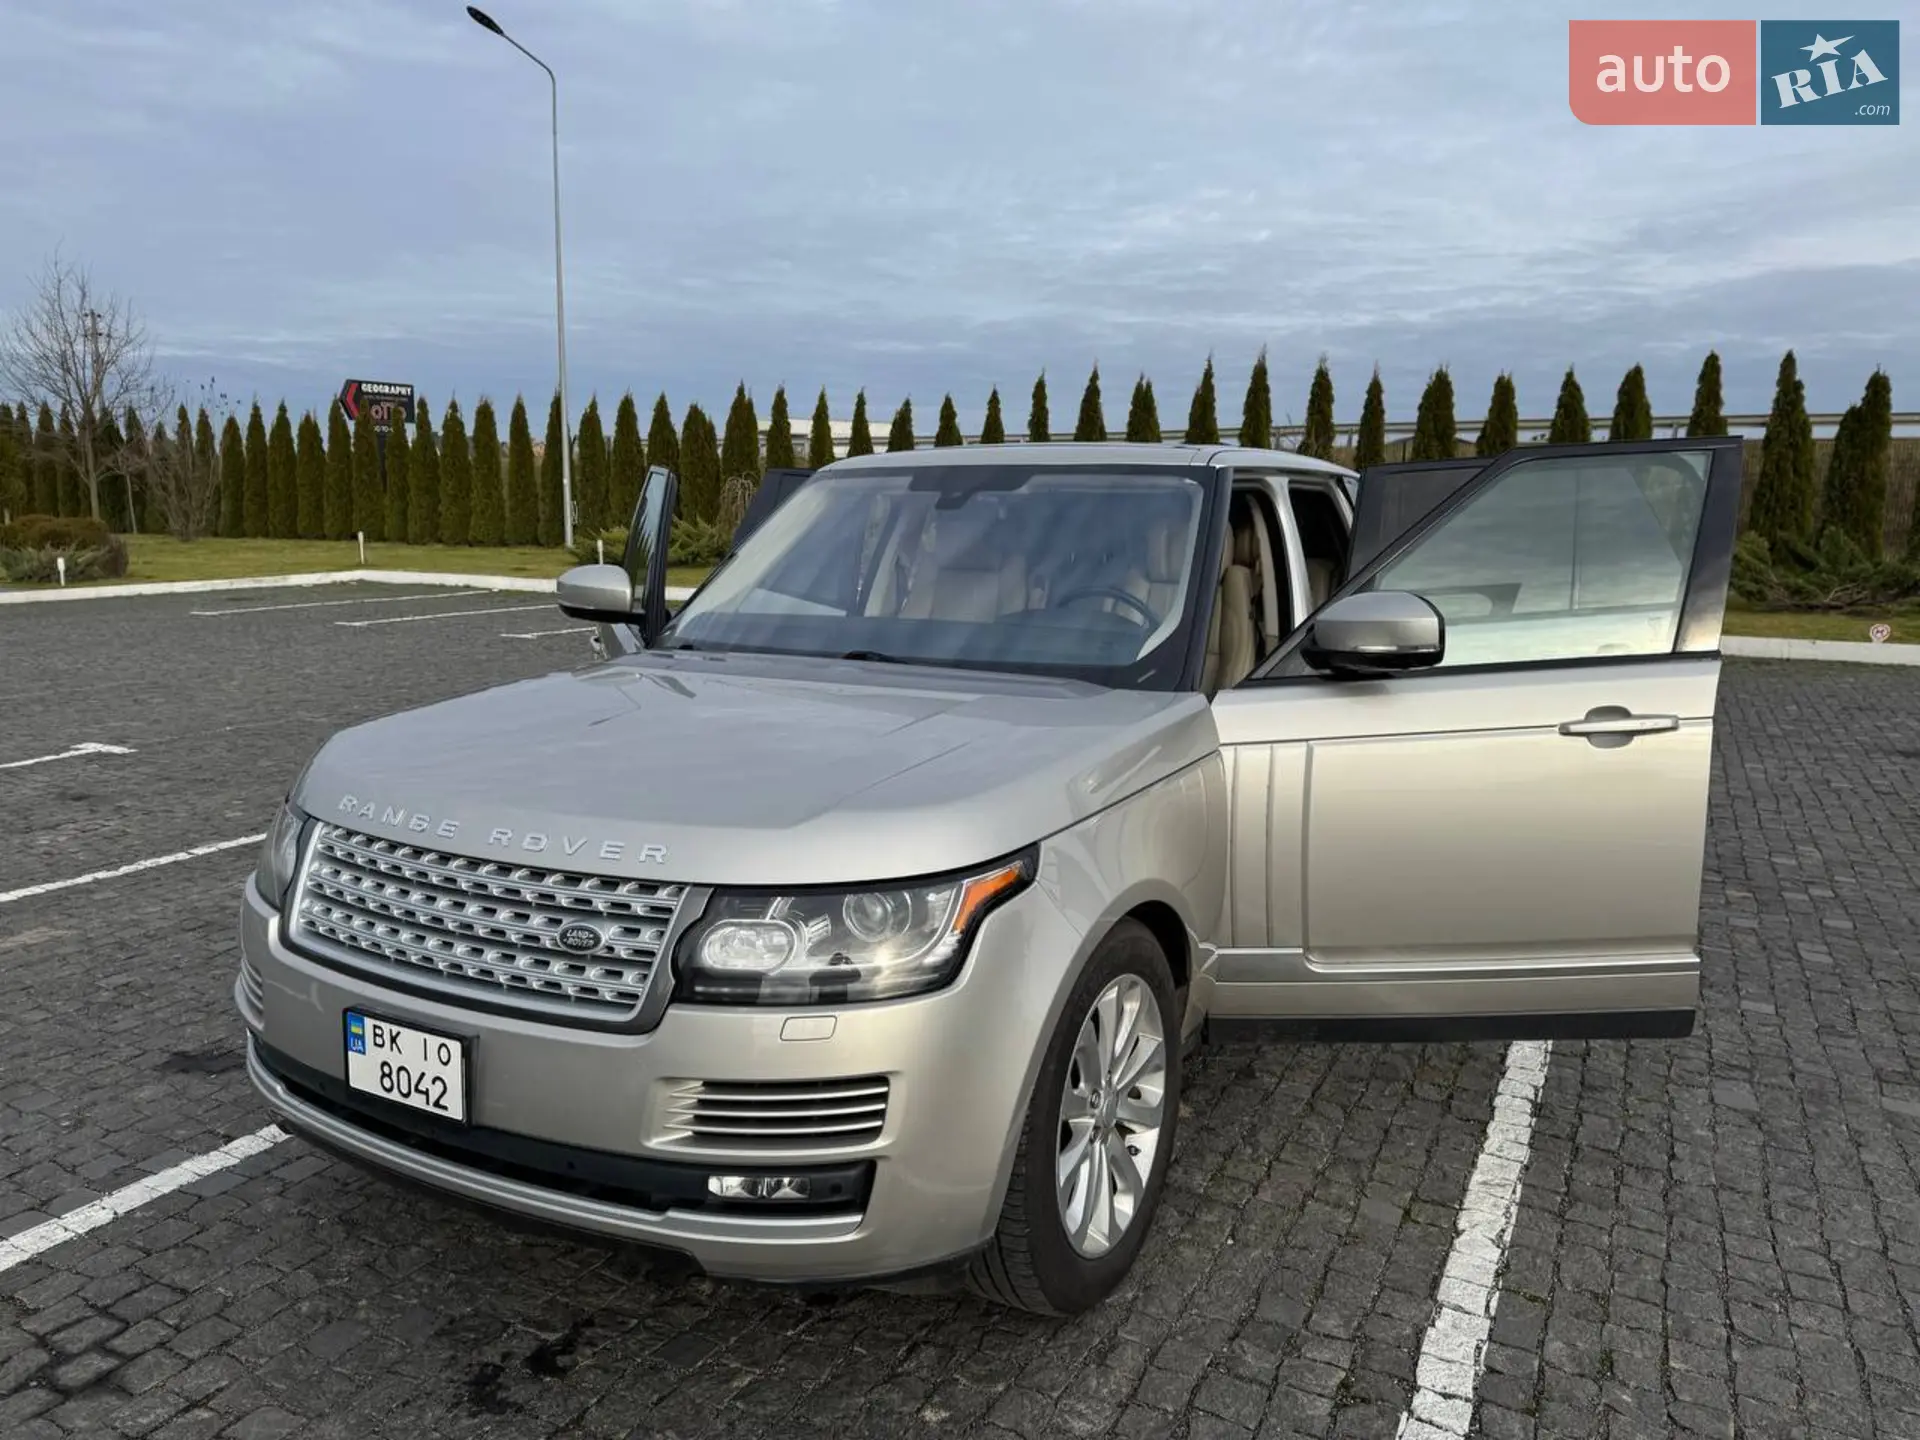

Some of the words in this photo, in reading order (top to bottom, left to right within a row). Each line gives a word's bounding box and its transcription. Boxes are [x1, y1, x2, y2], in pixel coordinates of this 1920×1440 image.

[360, 383, 412, 396] GEOGRAPHY
[339, 795, 460, 839] RANGE
[488, 828, 668, 864] ROVER
[372, 1023, 403, 1055] BK
[379, 1060, 449, 1112] 8042
